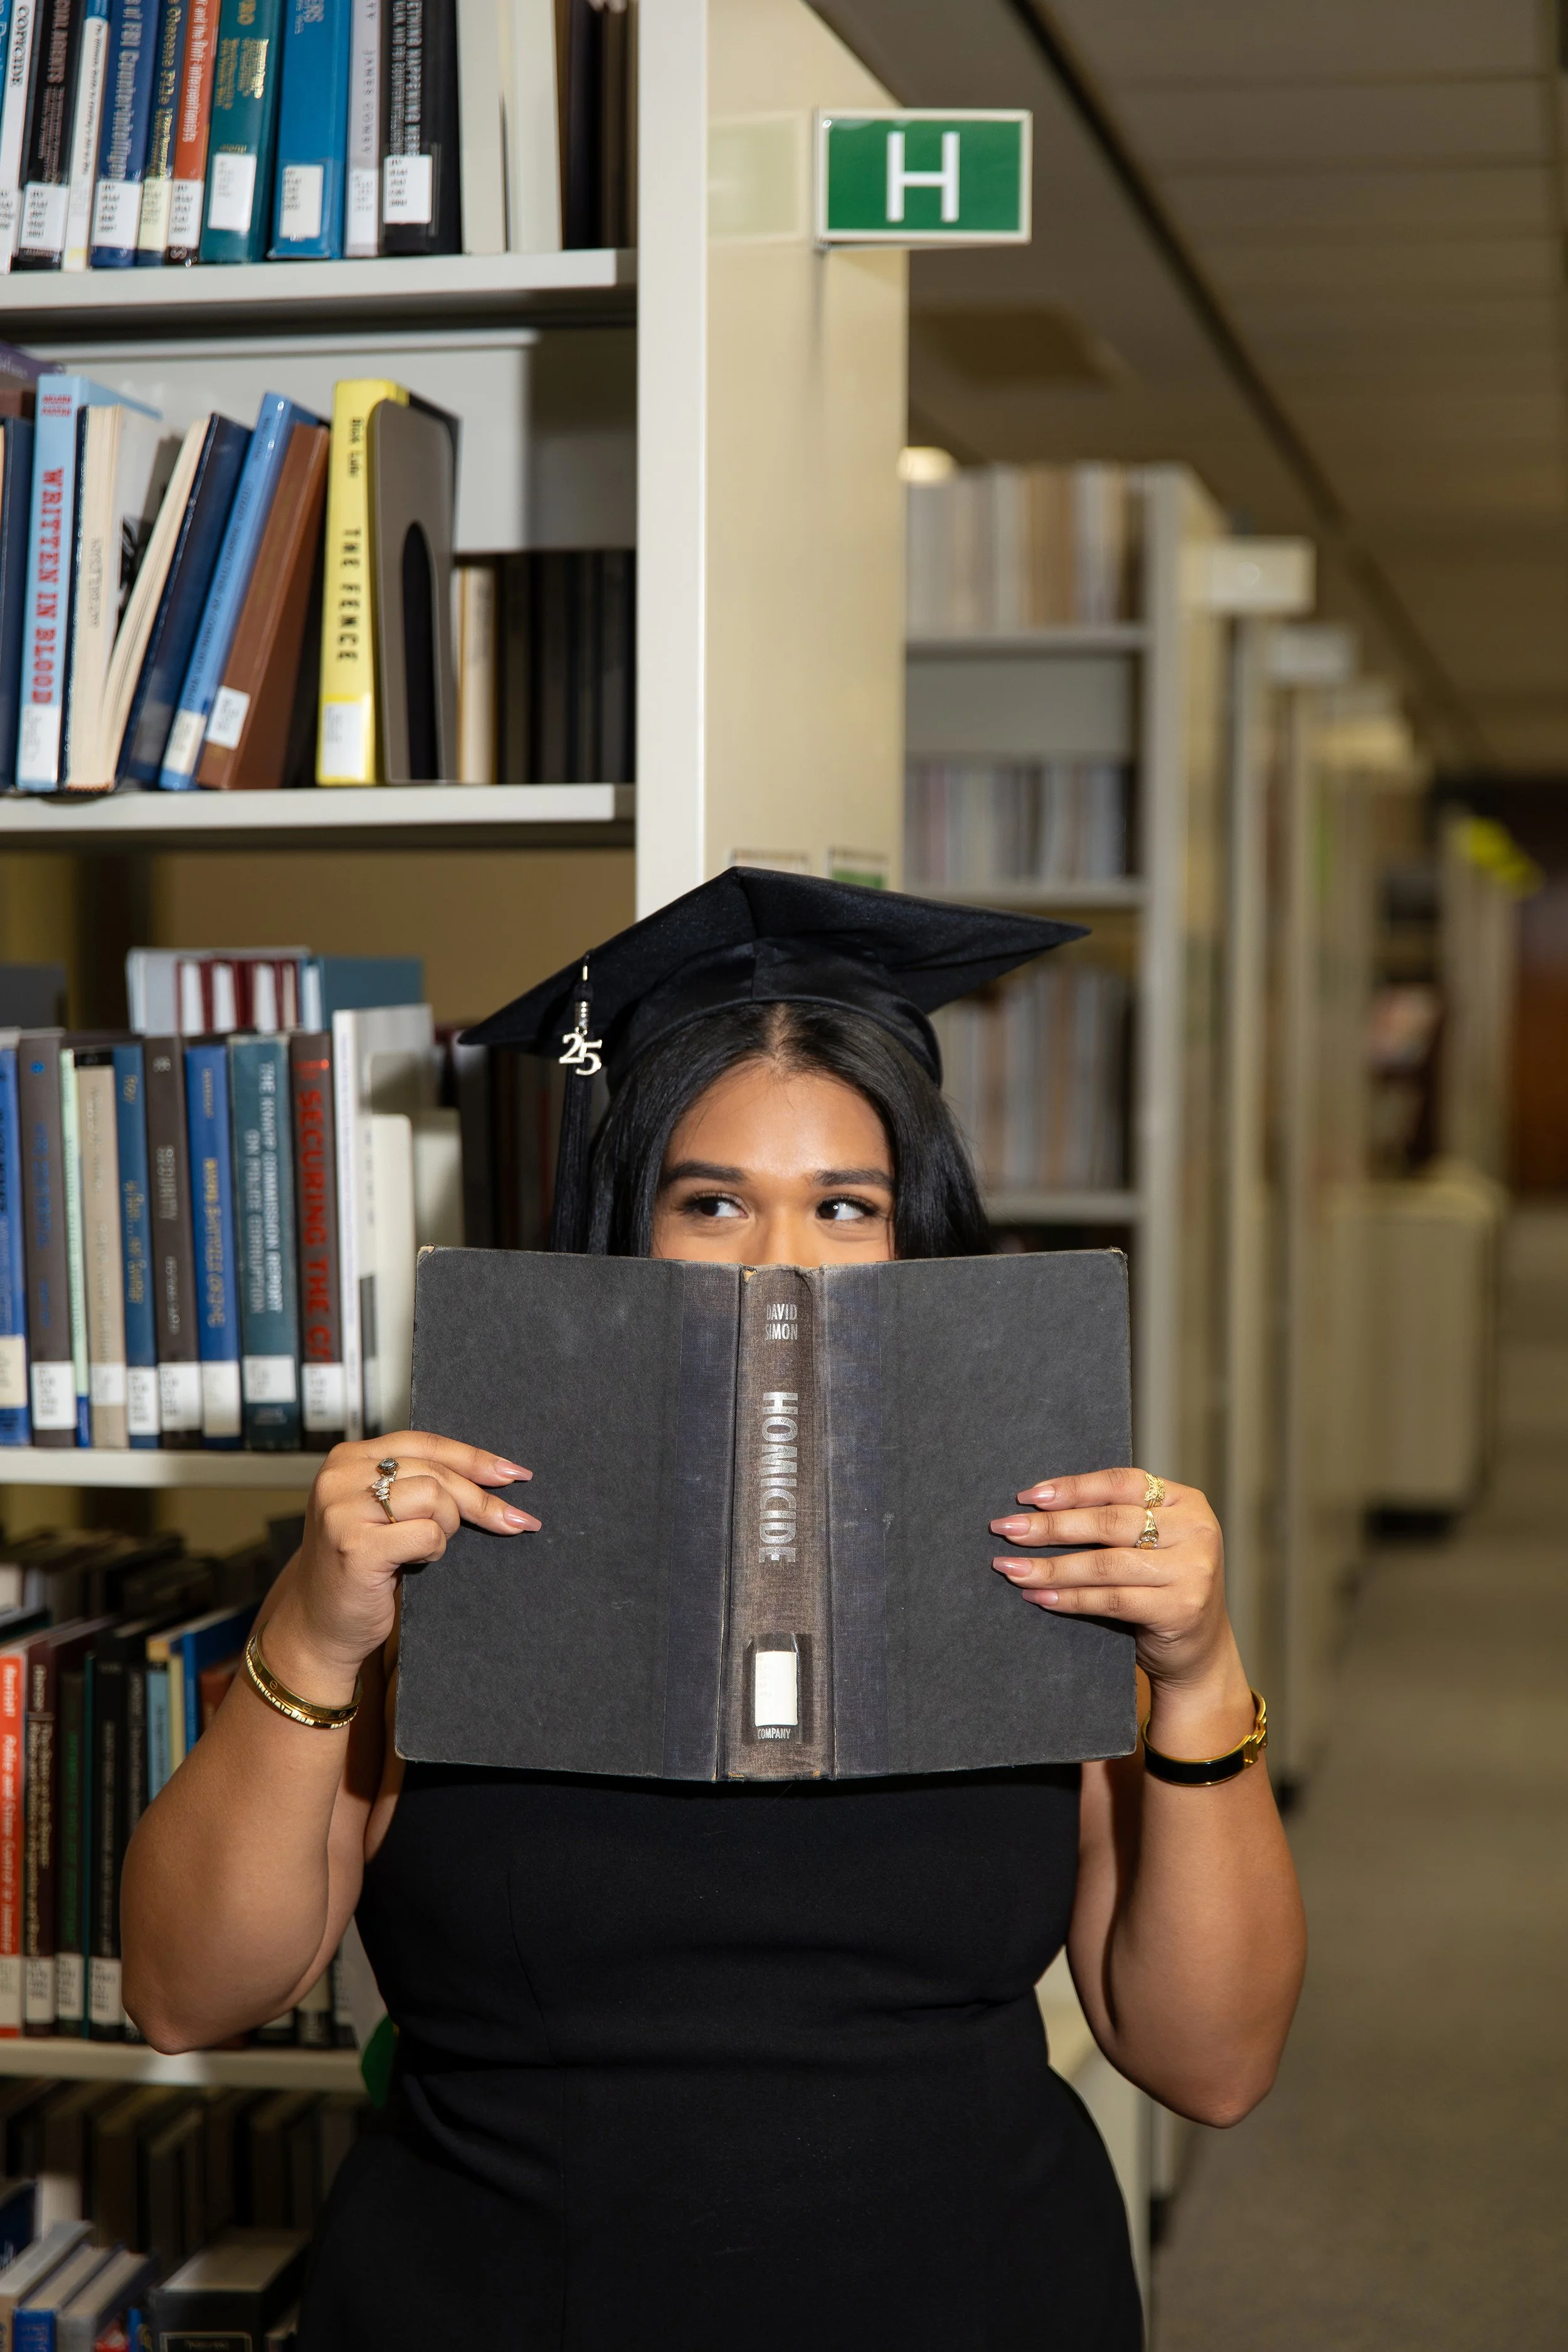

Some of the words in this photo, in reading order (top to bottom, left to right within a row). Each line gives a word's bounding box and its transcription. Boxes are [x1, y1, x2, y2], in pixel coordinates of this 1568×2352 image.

[120, 21, 142, 47] FBI
[191, 24, 207, 40] the
[193, 7, 209, 24] and
[10, 5, 29, 88] COPICIDE
[47, 29, 67, 84] AGENTS
[363, 50, 376, 95] JAMES
[361, 100, 376, 154] COMEY
[886, 130, 960, 223] H
[38, 467, 65, 585] WRITTEN
[341, 527, 362, 568] THE
[36, 591, 60, 621] IN
[337, 583, 361, 663] FENCE
[31, 627, 57, 704] BLOOD
[259, 1062, 276, 1094] THE
[559, 1033, 603, 1076] 25
[245, 1157, 264, 1214] POLICE
[299, 1091, 327, 1246] SECURING
[262, 1152, 280, 1249] COMMISSION
[247, 1214, 267, 1314] CORRUPTION
[266, 1251, 283, 1313] REPORT
[305, 1256, 330, 1315] THE
[765, 1323, 798, 1340] SIMON
[766, 1303, 798, 1320] DAVID
[759, 1391, 798, 1564] HOMICIDE
[758, 1728, 791, 1740] COMPANY
